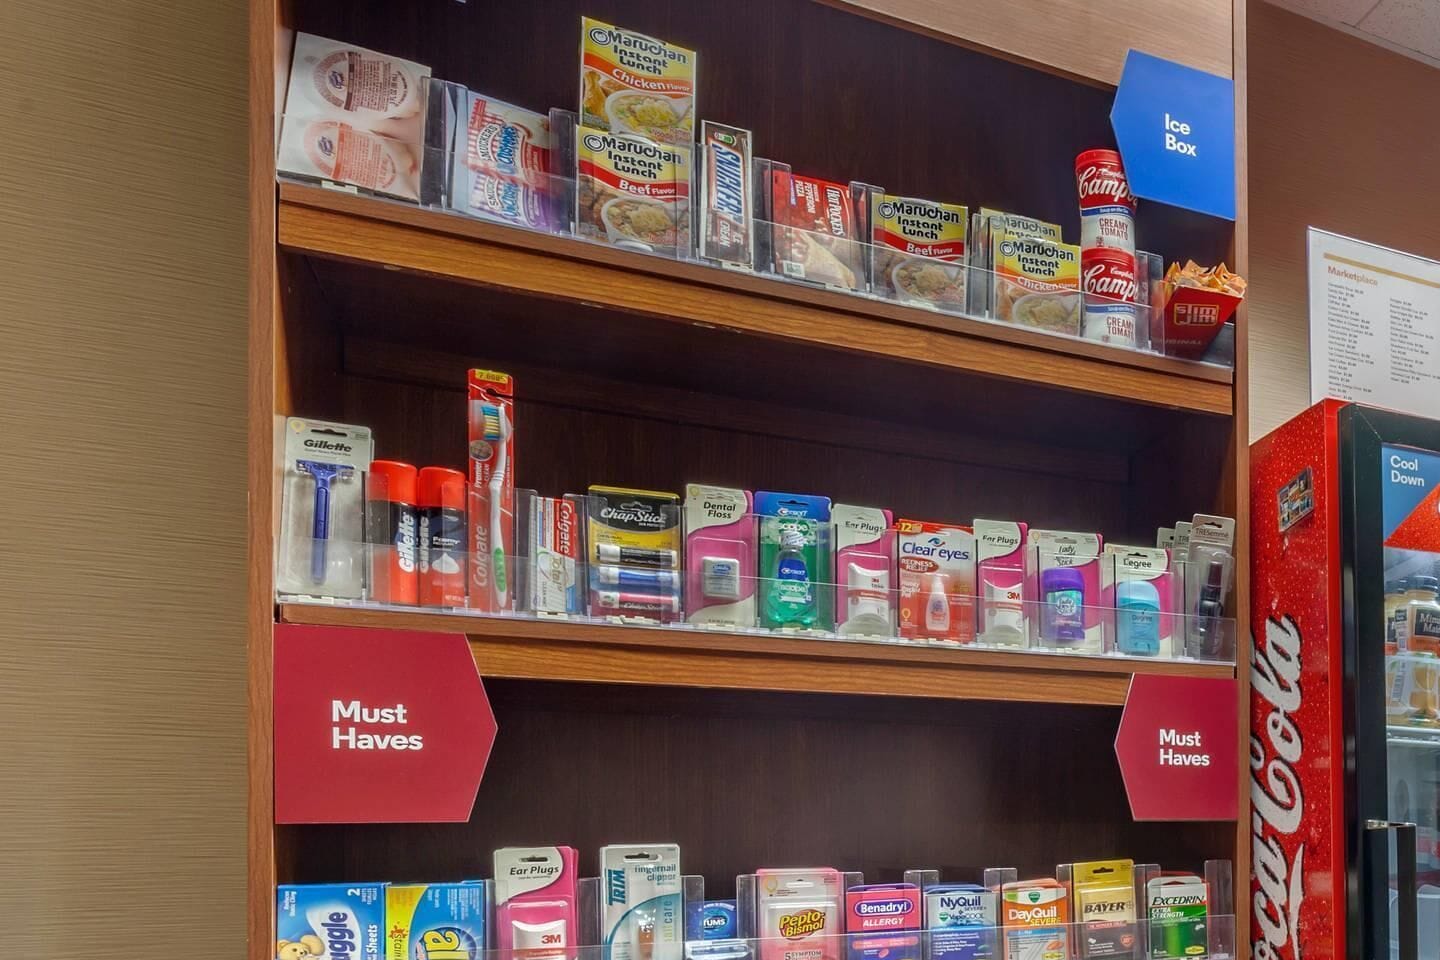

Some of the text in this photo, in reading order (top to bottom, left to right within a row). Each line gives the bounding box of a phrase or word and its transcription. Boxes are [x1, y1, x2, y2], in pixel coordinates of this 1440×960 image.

[608, 30, 687, 64] Maruchan
[613, 45, 668, 68] Instant
[620, 56, 662, 75] Lunch
[612, 68, 667, 90] Chicken
[1165, 113, 1191, 135] Ice
[602, 136, 682, 164] Maruchan
[1165, 133, 1197, 157] Box
[607, 151, 663, 171] Instant
[614, 162, 657, 179] Lunch
[619, 179, 676, 196] Beef Flavor
[893, 202, 960, 223] Maruchan
[898, 215, 943, 231] Instant
[1099, 217, 1128, 230] CREAMY
[903, 226, 938, 240] Lunch
[907, 243, 932, 256] Beef
[1013, 241, 1074, 261] Maruchan
[1018, 255, 1060, 269] Instant
[1022, 264, 1055, 277] Lunch
[1017, 277, 1058, 291] Chicken
[1328, 266, 1378, 285] Marketplace
[304, 439, 352, 453] Gillette
[1391, 455, 1418, 471] Cool
[474, 459, 484, 489] Premier
[1391, 470, 1425, 487] Down
[600, 508, 667, 523] ChapStick
[703, 502, 736, 512] Dental
[707, 510, 732, 519] Floss
[558, 502, 572, 556] Colgate
[398, 511, 416, 573] Gillette
[982, 535, 1018, 546] Ear Plugs
[473, 525, 490, 587] Colgate
[902, 542, 969, 561] Clear eyes
[551, 557, 562, 585] Total
[901, 558, 933, 568] REDNESS
[1007, 592, 1020, 600] 3M
[332, 700, 407, 723] Must
[332, 727, 423, 750] Haves
[1159, 729, 1201, 746] Must
[1159, 749, 1210, 766] Haves
[510, 865, 559, 877] Ear Plugs
[348, 888, 360, 896] 2
[608, 868, 626, 906] TRIM
[860, 902, 907, 914] Benadryl
[940, 896, 981, 910] NyQuil
[1084, 902, 1125, 914] BAYER
[664, 901, 673, 924] care
[779, 911, 827, 929] Pepto-
[1009, 906, 1057, 922] DayQuil
[1152, 911, 1184, 919] STRENGTH
[785, 921, 825, 937] Bismol
[863, 917, 904, 927] ALLERGY
[366, 924, 378, 957] Sheets
[541, 935, 561, 944] 3M
[785, 952, 791, 960] 5
